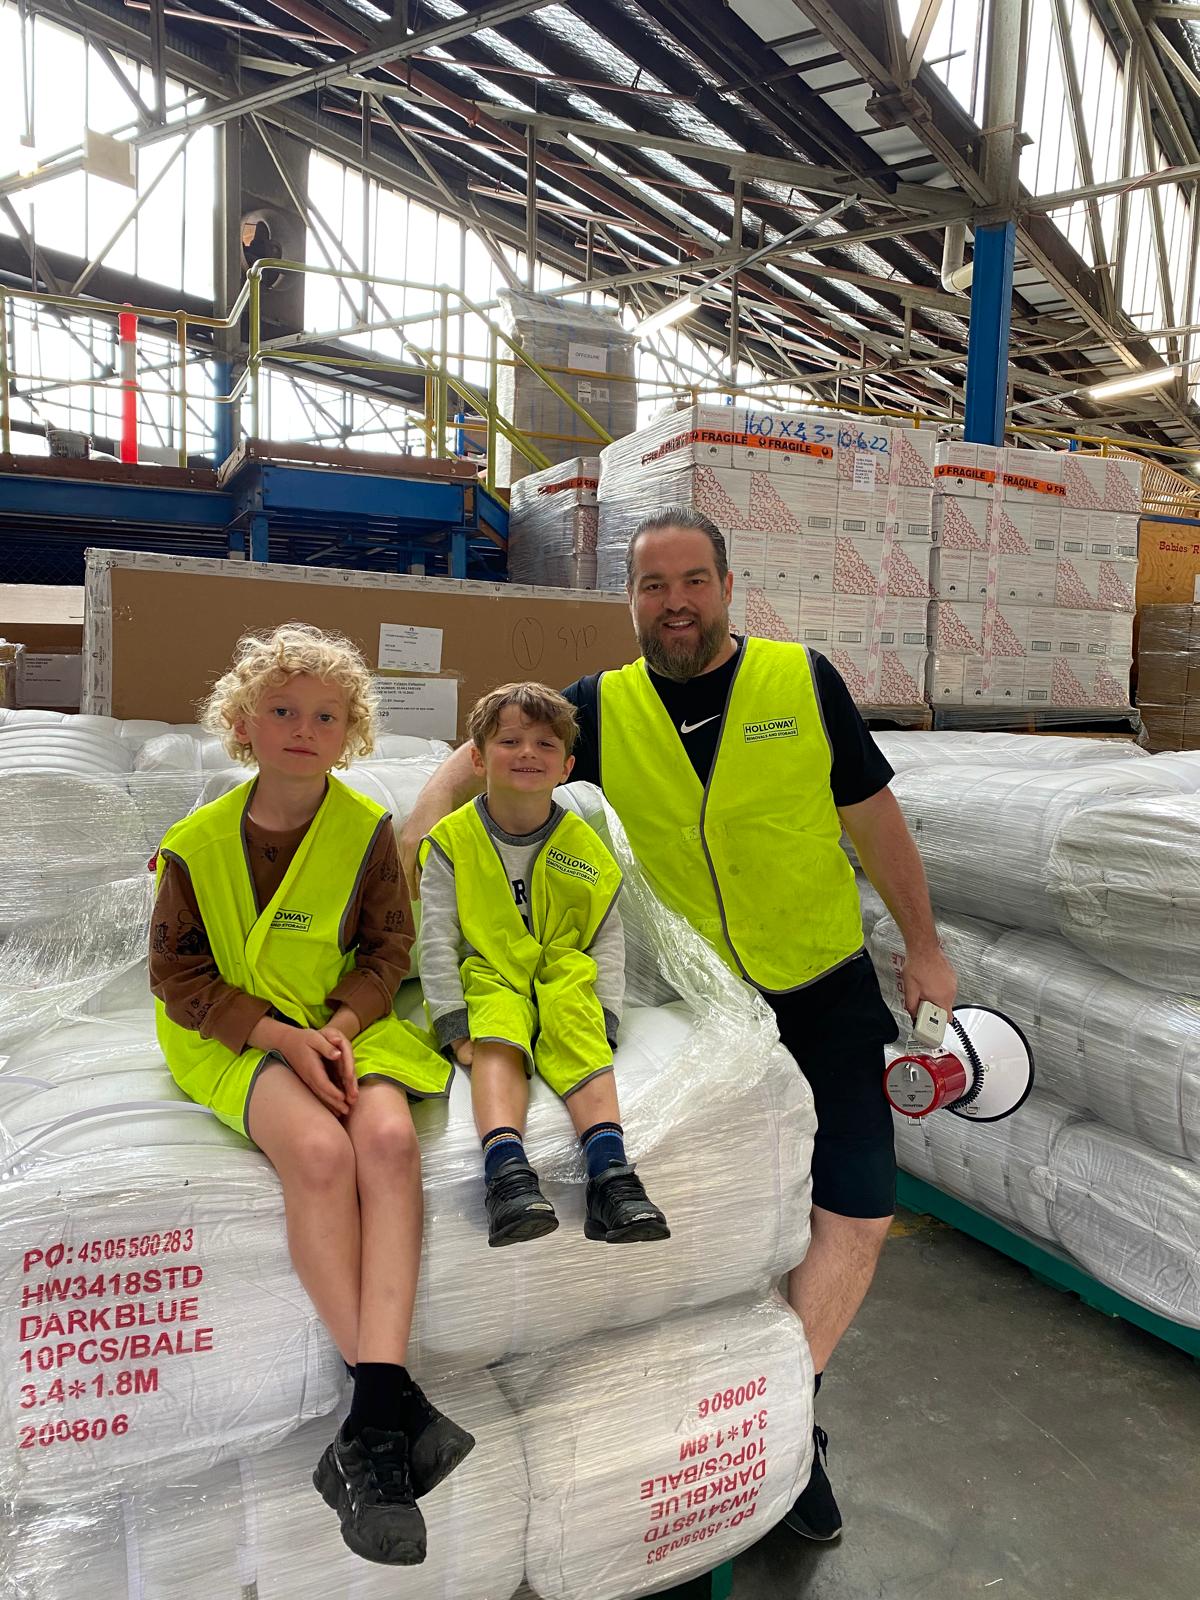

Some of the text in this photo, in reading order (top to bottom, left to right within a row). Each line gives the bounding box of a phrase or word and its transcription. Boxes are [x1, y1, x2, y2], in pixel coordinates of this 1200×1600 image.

[701, 431, 748, 445] FRAGILE
[768, 439, 812, 454] FRAGILE
[584, 479, 598, 489] FR
[946, 466, 986, 480] FRAGILE
[1003, 474, 1039, 489] FRAGILE
[1159, 541, 1188, 552] Babies
[745, 719, 794, 734] HOLLOWAY
[548, 849, 599, 877] HOLLOWAY
[567, 868, 576, 876] AND
[22, 1228, 195, 1274] PO:4505500283
[21, 1265, 204, 1310] HW3418STD
[19, 1297, 200, 1342] DARKBLUE
[19, 1327, 214, 1374] 10PCS/BALE
[698, 1375, 768, 1418] 200806
[19, 1414, 129, 1450] 200806
[640, 1437, 767, 1501] 10PCS/BALE
[650, 1459, 767, 1521] DARKBLUE
[643, 1483, 763, 1544] HW3418STD
